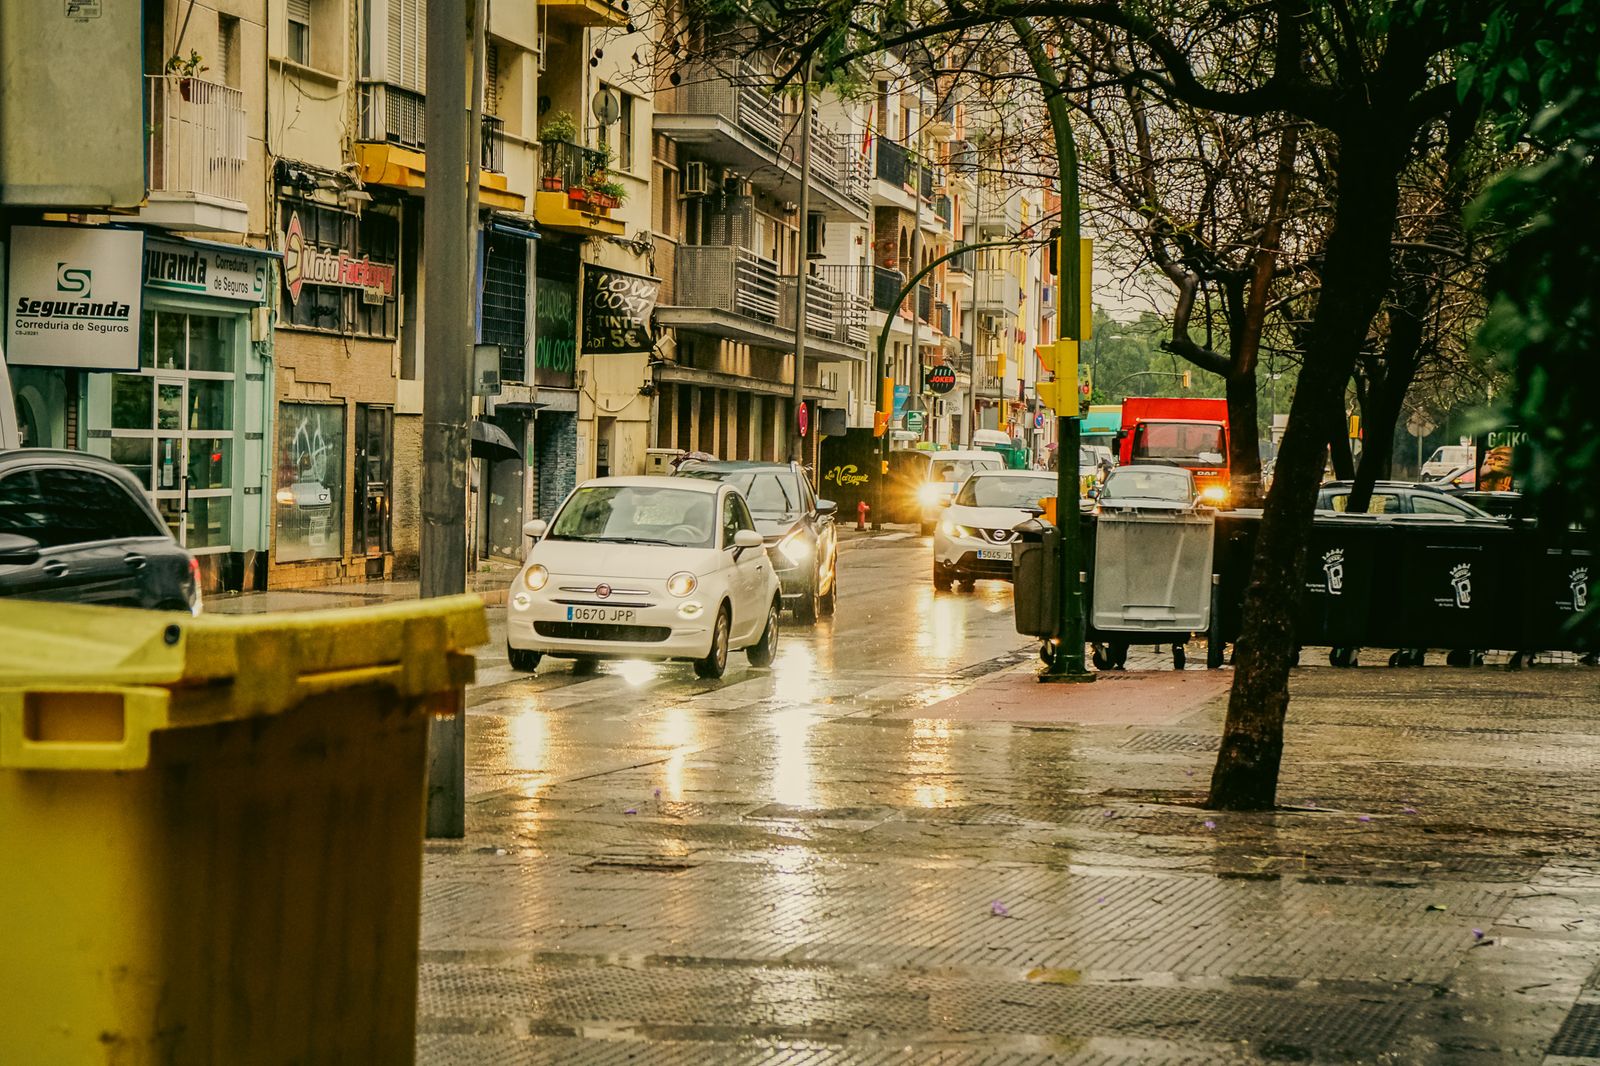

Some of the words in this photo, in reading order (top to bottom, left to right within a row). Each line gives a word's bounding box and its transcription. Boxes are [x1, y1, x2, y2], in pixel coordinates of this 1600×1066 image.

[215, 254, 249, 273] Correduria
[303, 245, 392, 295] MotoFactory
[214, 276, 222, 290] de
[223, 277, 249, 296] Seguros
[596, 273, 656, 298] LOW
[16, 297, 130, 318] Seguranda
[594, 290, 650, 310] COST
[16, 319, 69, 331] Correduria
[72, 322, 84, 331] de
[87, 323, 129, 334] Seguros
[595, 314, 642, 330] TINTE
[610, 329, 641, 348] 5€
[536, 336, 552, 369] OW
[982, 550, 1001, 559] 5045
[575, 608, 606, 621] 0670
[610, 609, 634, 622] JPP
